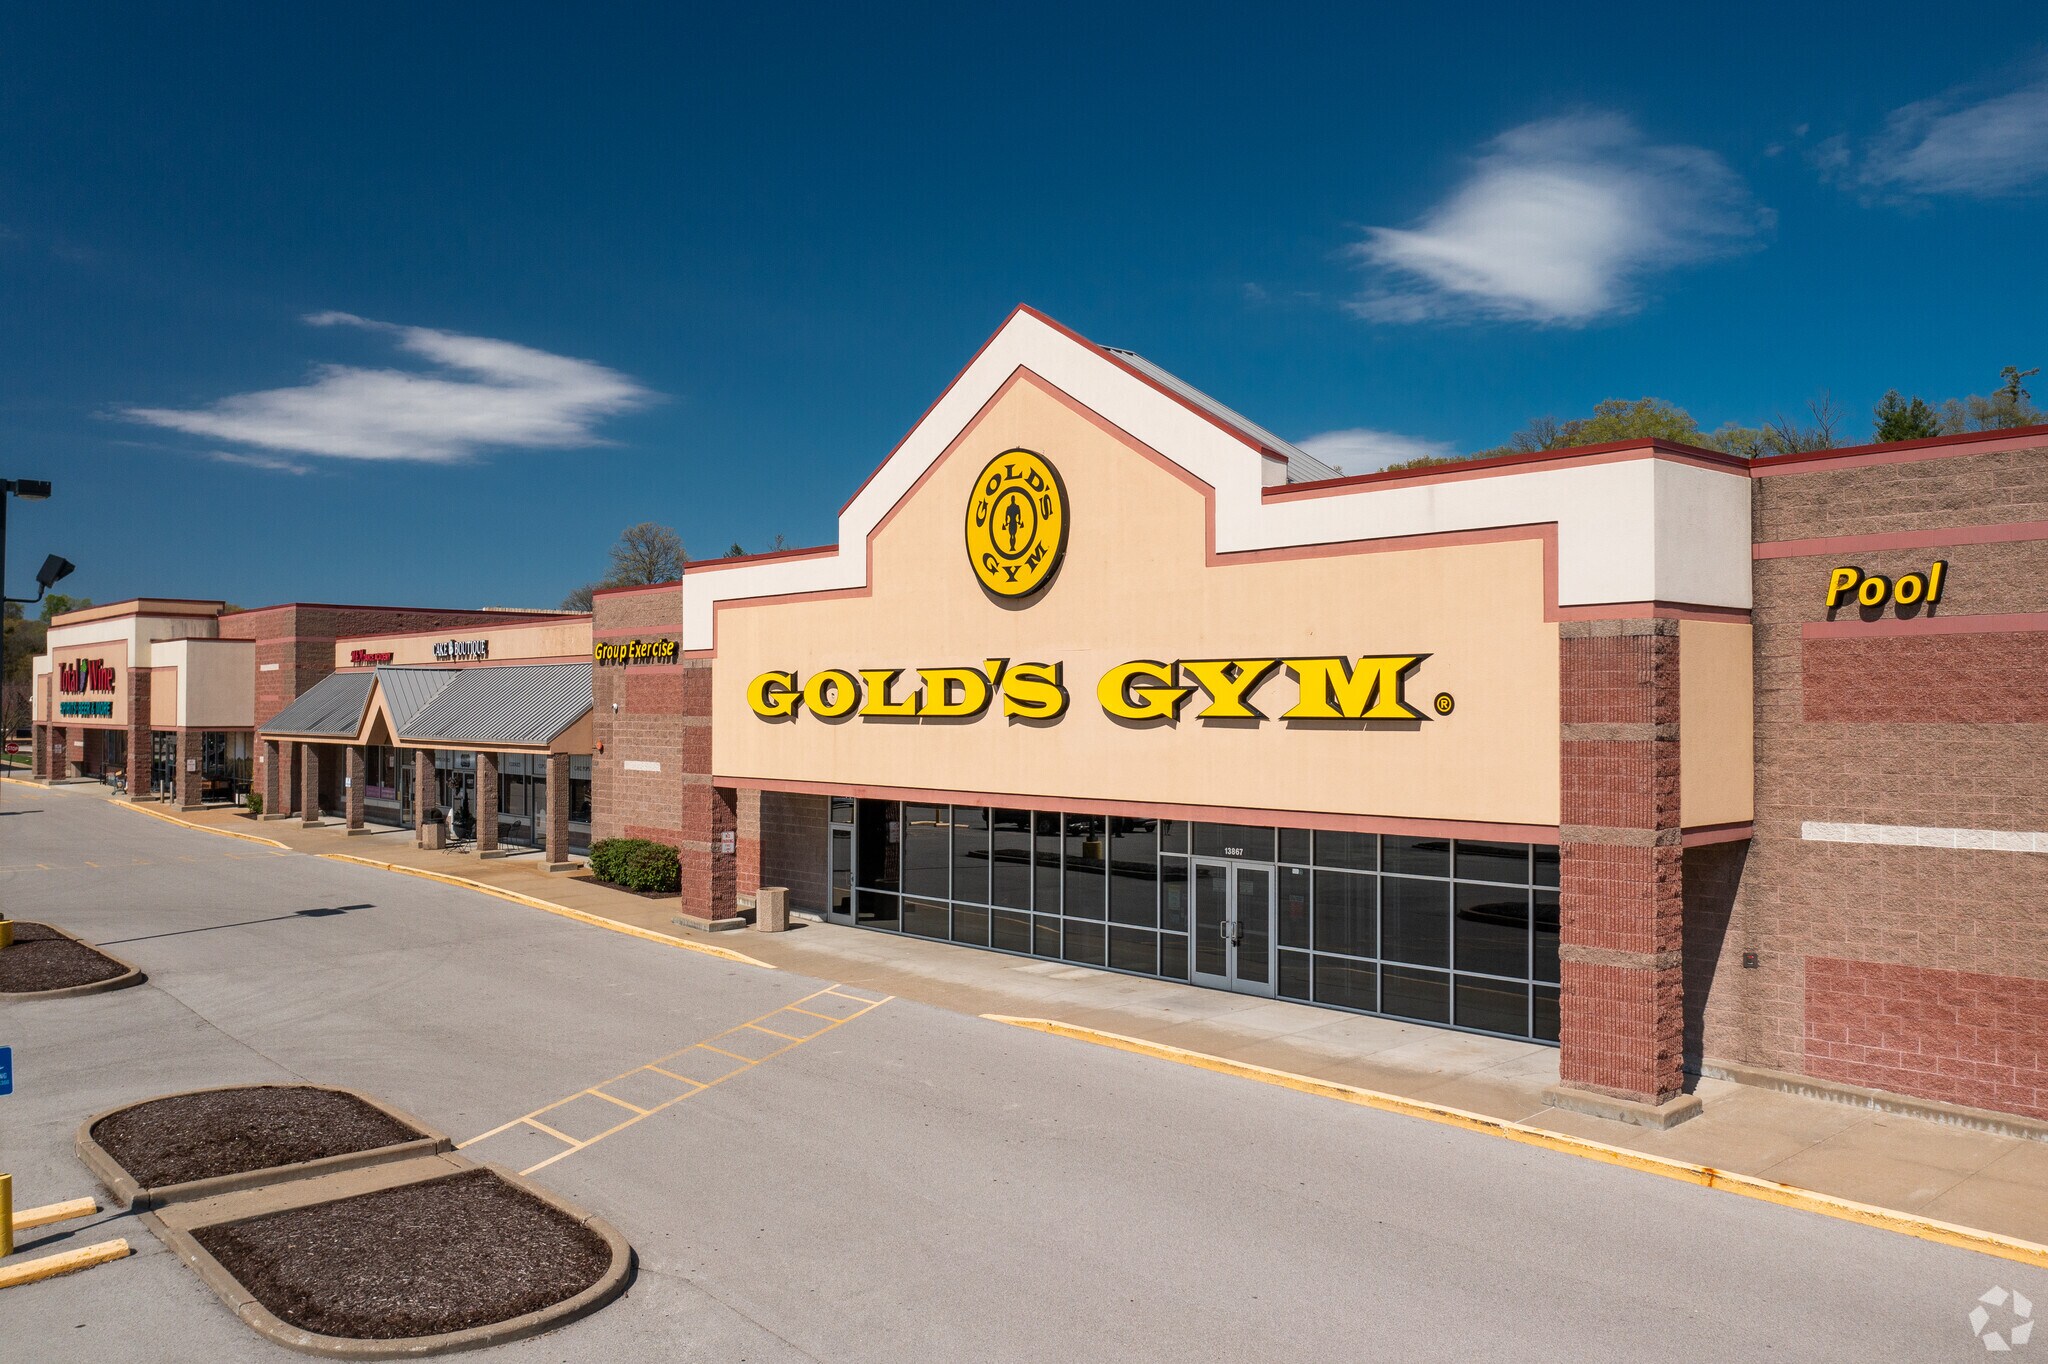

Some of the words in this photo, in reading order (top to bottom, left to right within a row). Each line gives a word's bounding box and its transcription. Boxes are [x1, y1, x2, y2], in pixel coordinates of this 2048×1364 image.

[975, 463, 1053, 528] GOLD'S
[982, 540, 1049, 583] GYM
[1825, 560, 1948, 608] Pool
[432, 642, 449, 657] CAKE
[454, 640, 488, 656] BOUTIQUE
[594, 641, 628, 663] Group
[628, 638, 677, 658] Exercise
[58, 658, 81, 692] Total
[87, 658, 115, 692] Wine
[746, 657, 1070, 721] GOLD'S
[1096, 652, 1434, 721] GYM
[1224, 847, 1244, 856] 13867
